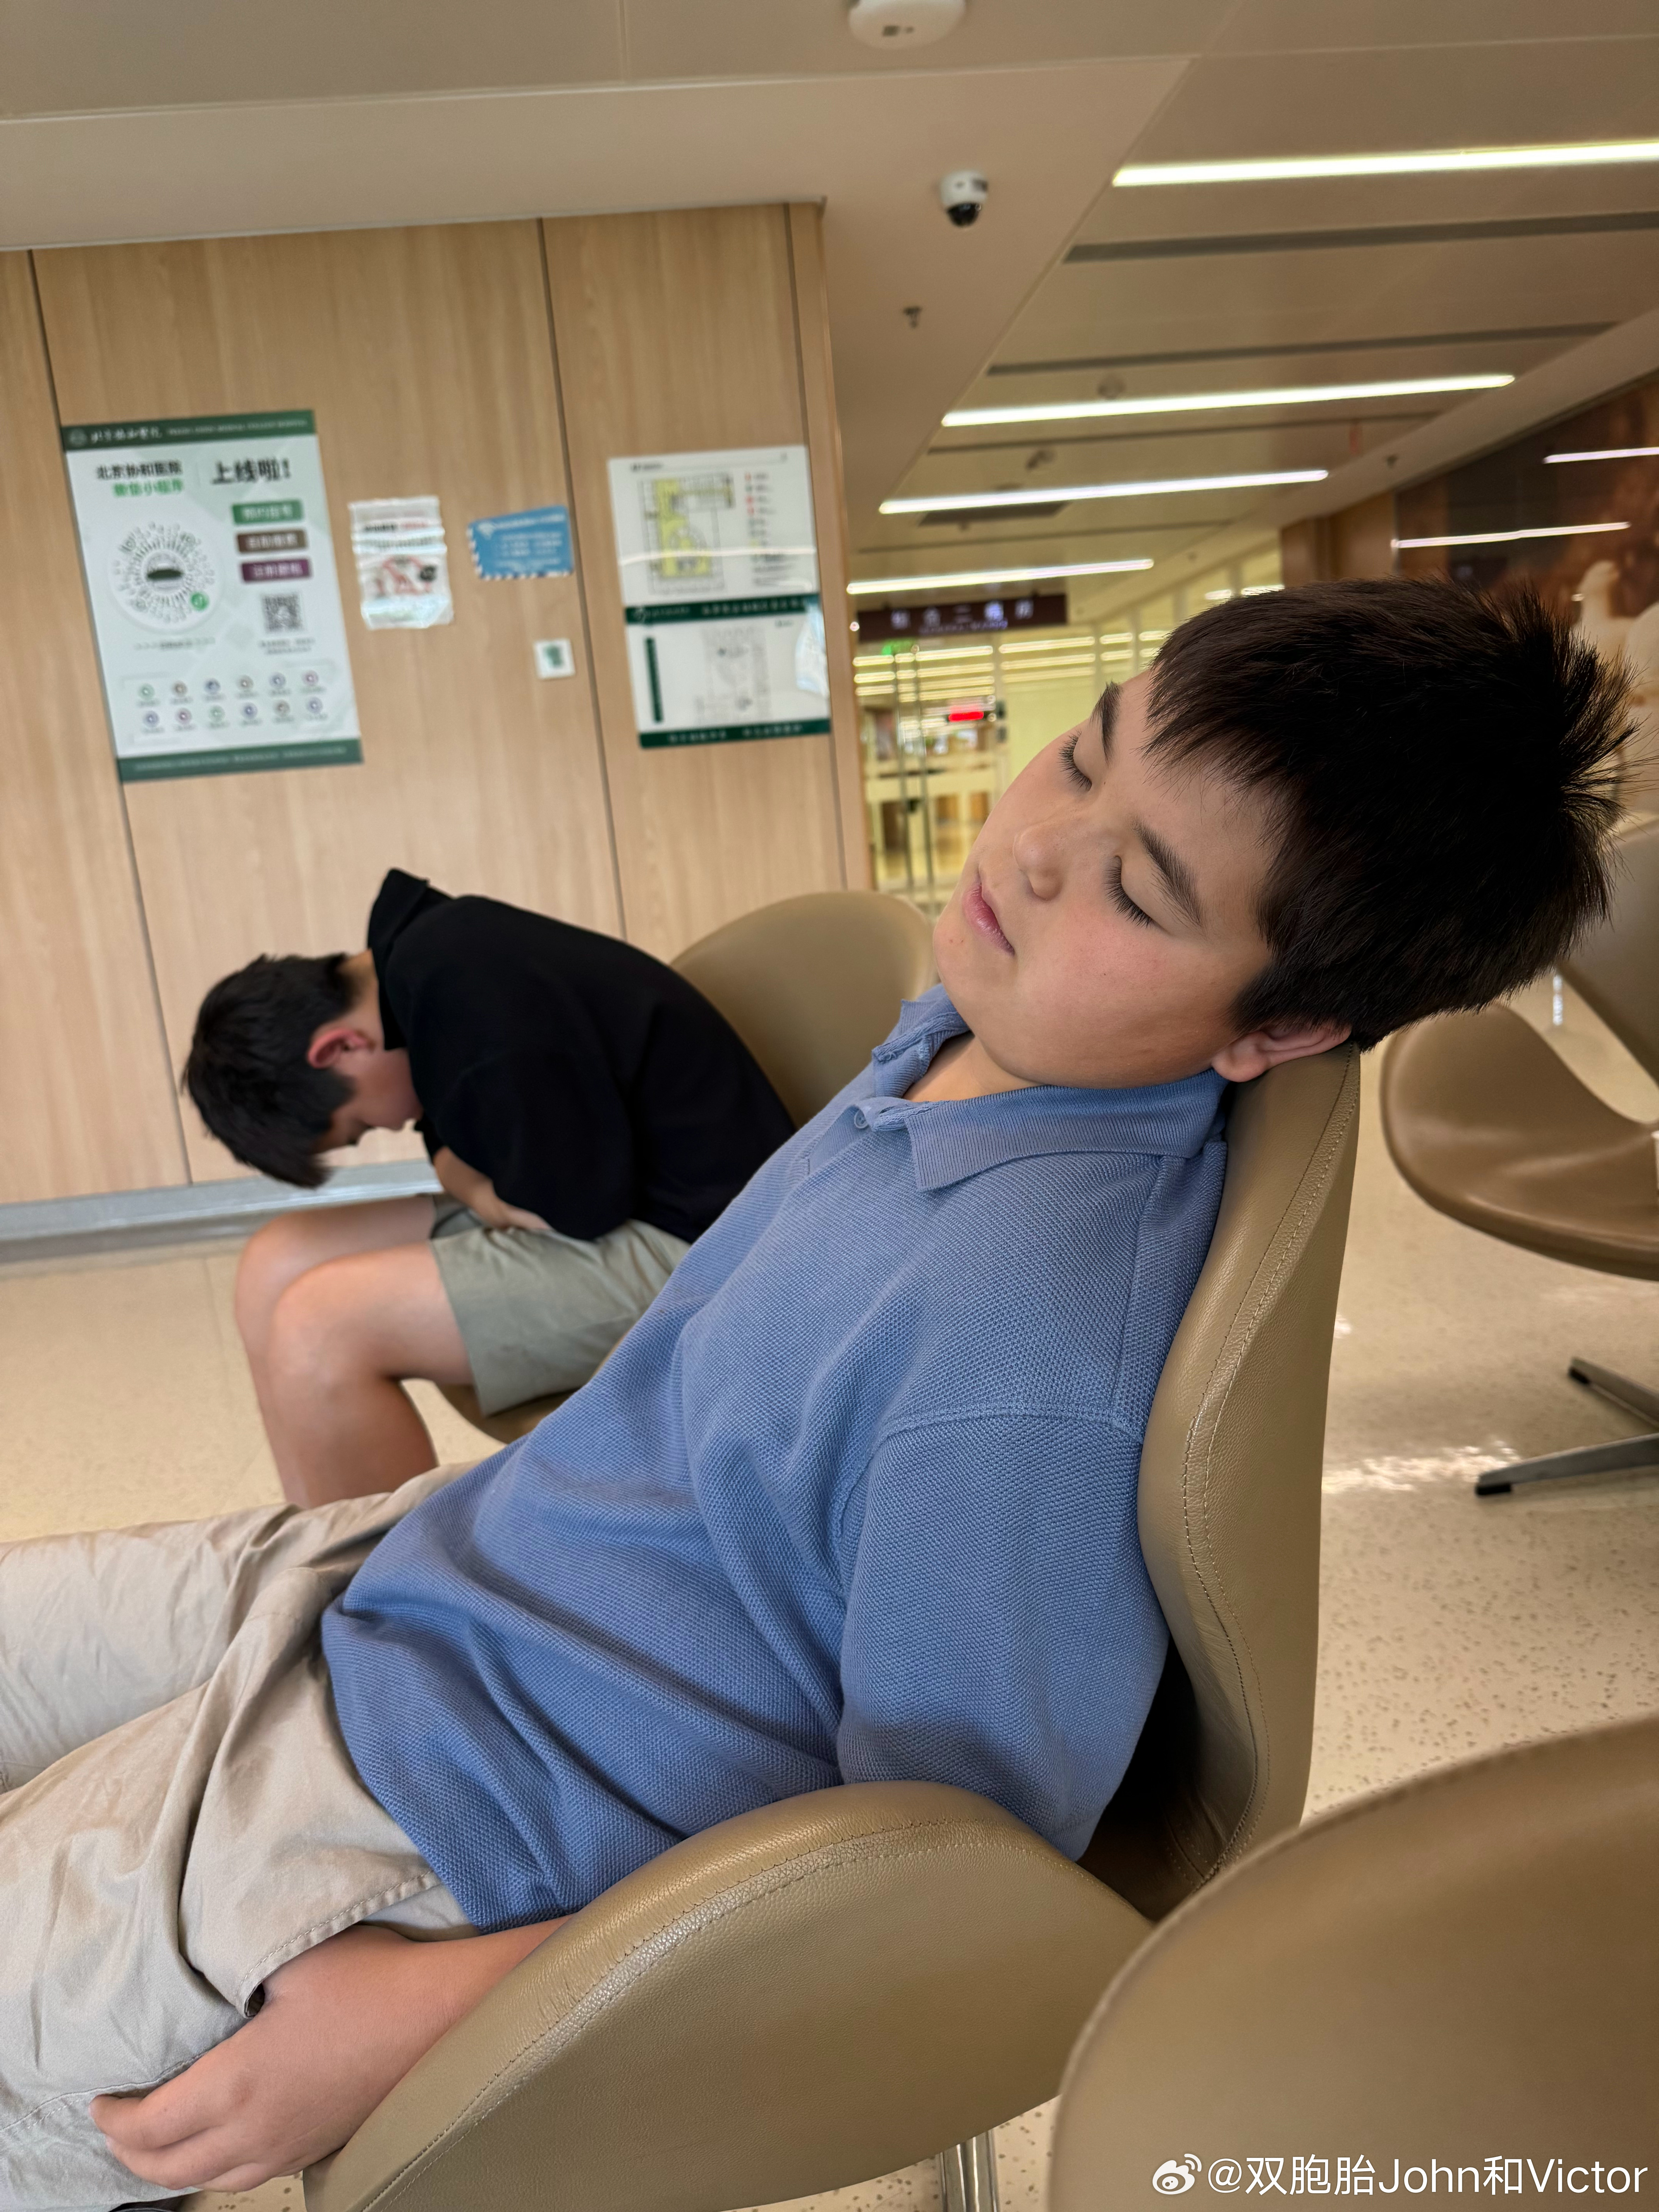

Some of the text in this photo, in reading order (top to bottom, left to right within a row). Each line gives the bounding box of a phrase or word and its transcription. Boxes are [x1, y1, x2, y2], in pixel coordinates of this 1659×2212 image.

[97, 460, 182, 479] 北京协和医院
